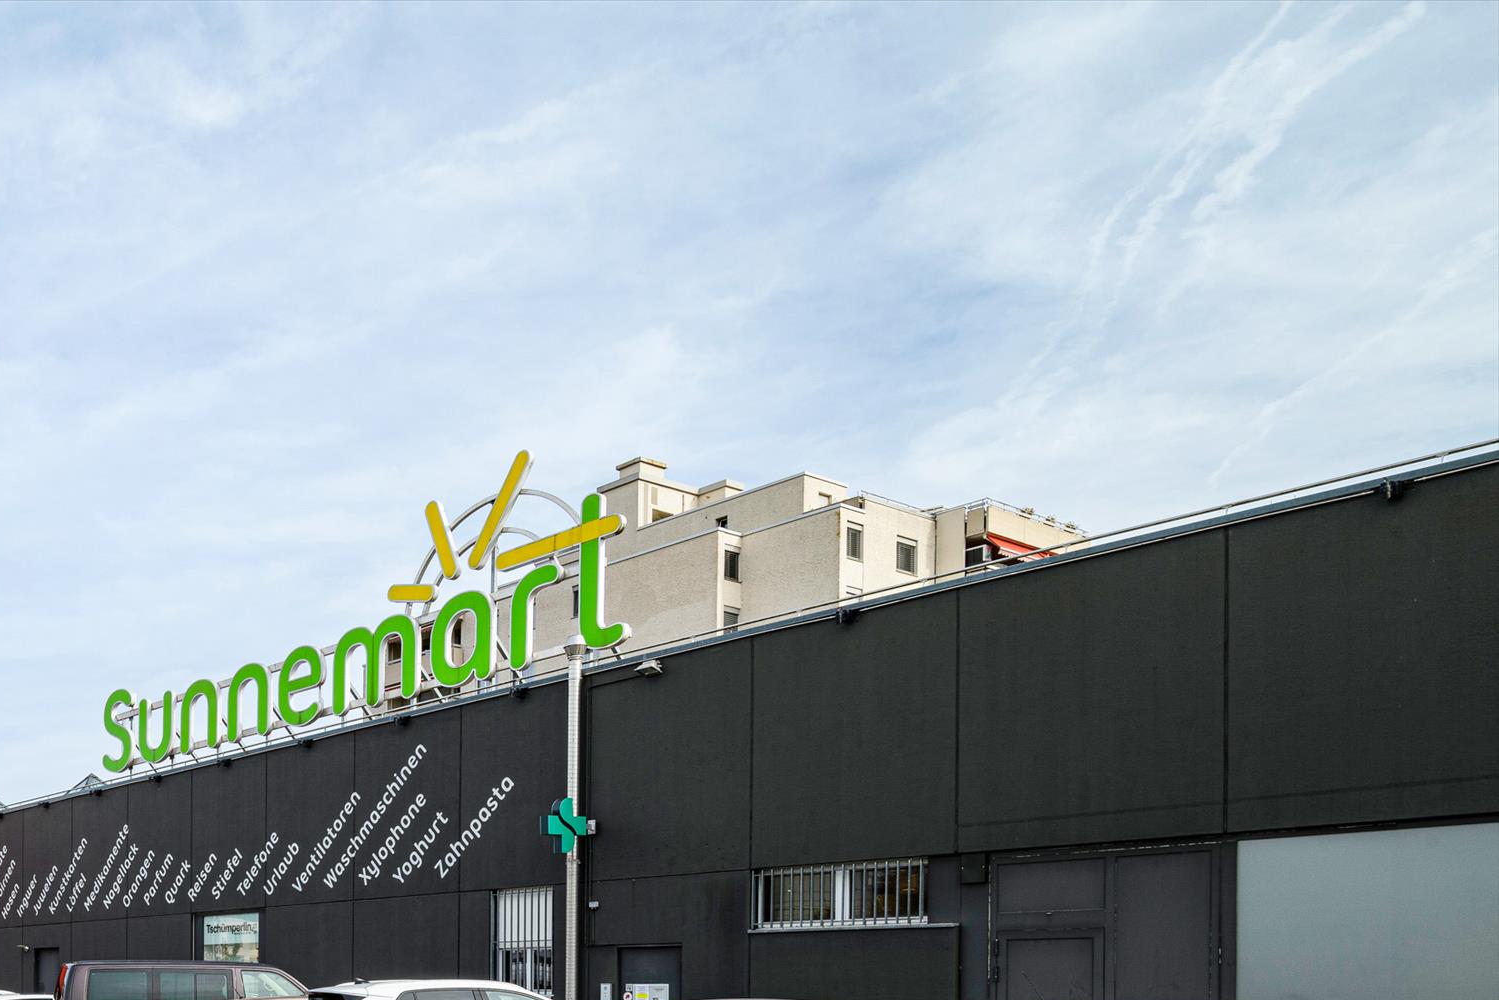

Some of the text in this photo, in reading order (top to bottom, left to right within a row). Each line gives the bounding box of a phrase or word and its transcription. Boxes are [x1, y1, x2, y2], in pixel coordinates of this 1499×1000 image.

[292, 791, 361, 894] Ventilatoren
[323, 743, 428, 890] Waschmaschinen
[358, 791, 427, 886] Xylophone
[434, 776, 515, 879] Zahnpasta
[48, 838, 88, 915] Kunstkarten
[83, 824, 130, 912] Medikamente
[102, 843, 139, 910] Nagellack
[187, 853, 218, 902] Reisen
[211, 848, 243, 900] Stiefel
[236, 831, 280, 897] Telefone
[263, 841, 301, 897] Urlaub
[392, 811, 449, 885] Yoghurt
[1, 883, 20, 920] Hosen
[16, 874, 38, 918] Ingwer
[33, 865, 59, 916] Juwelen
[66, 873, 87, 913] Löffel
[122, 849, 156, 908] Orangen
[143, 853, 174, 906] Parfum
[164, 860, 192, 904] Quark
